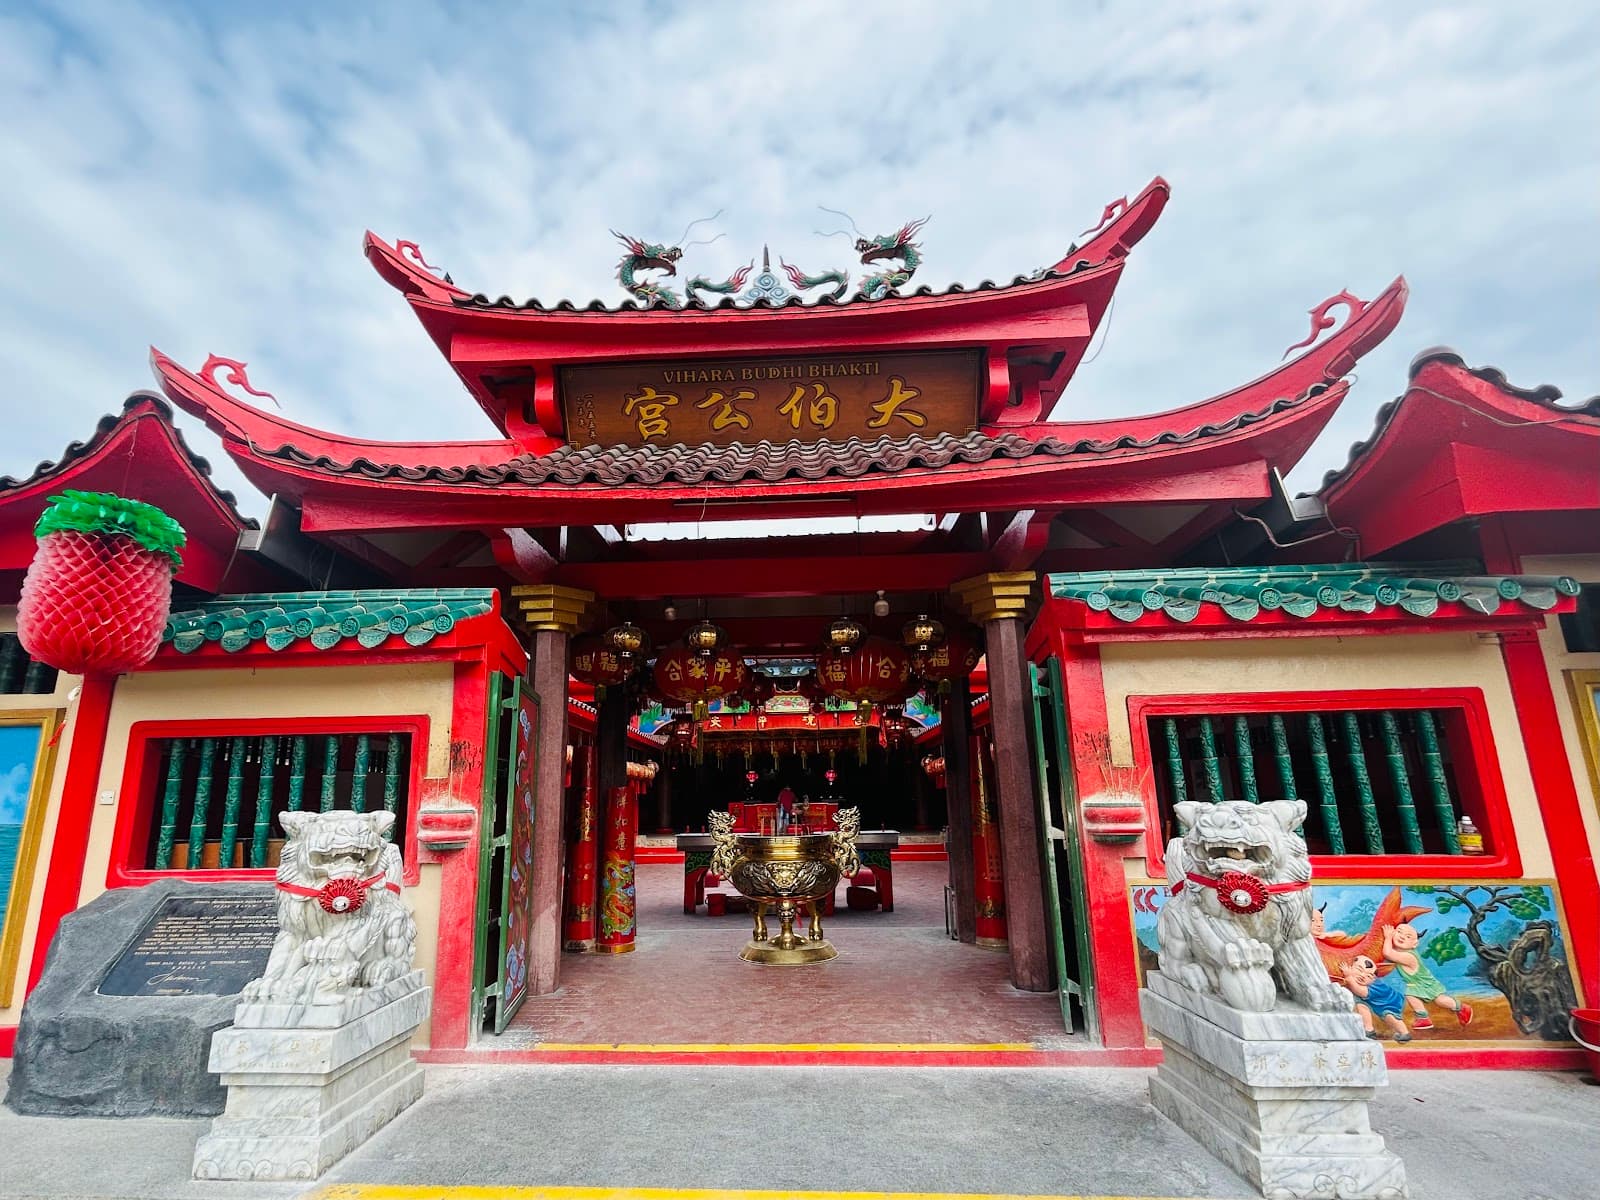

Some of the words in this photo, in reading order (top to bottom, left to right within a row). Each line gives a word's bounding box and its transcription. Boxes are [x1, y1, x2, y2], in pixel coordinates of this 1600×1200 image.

[663, 369, 736, 385] VIHARA
[740, 365, 803, 381] BUDHI
[808, 361, 880, 378] BHAKTI
